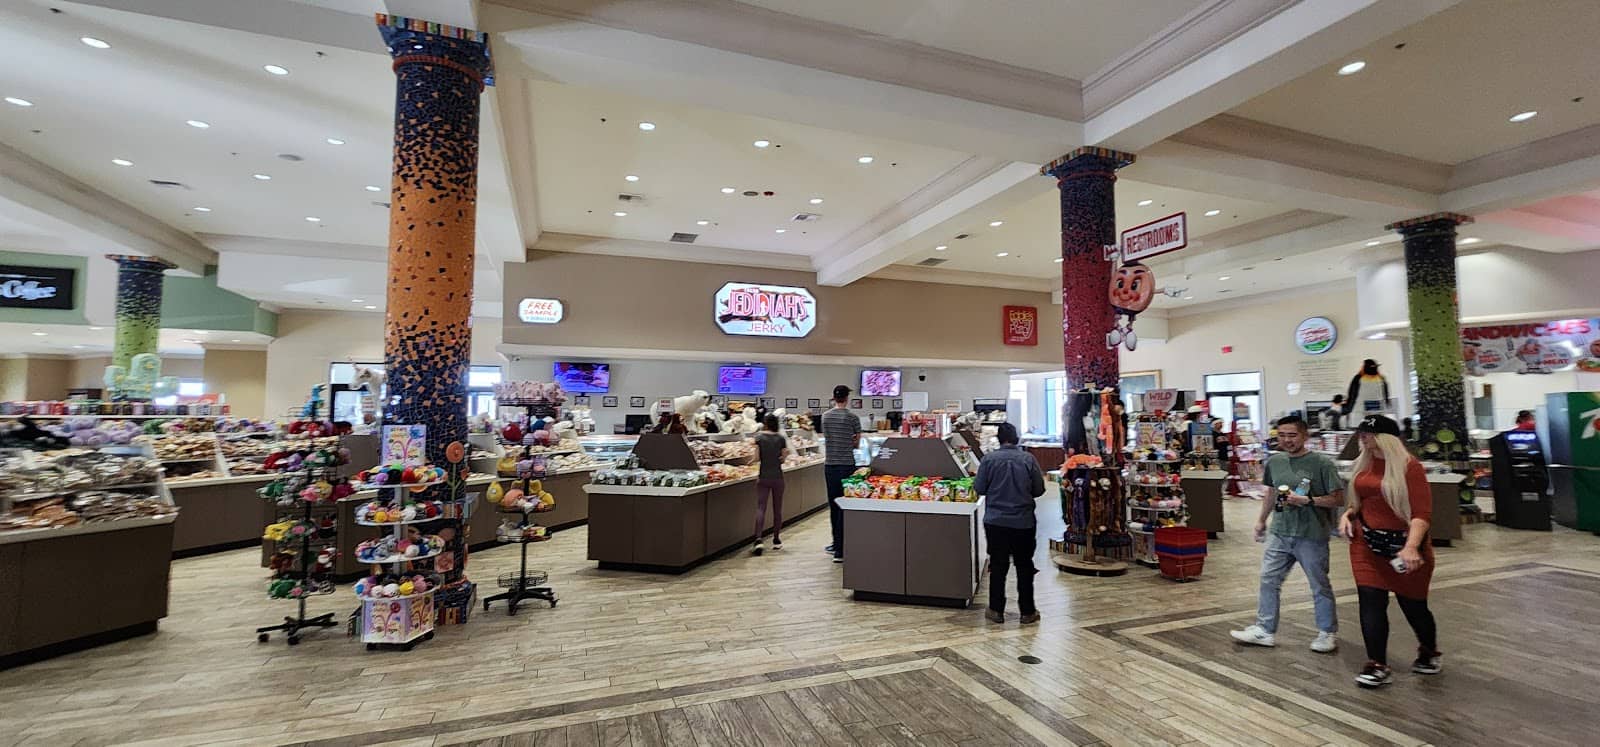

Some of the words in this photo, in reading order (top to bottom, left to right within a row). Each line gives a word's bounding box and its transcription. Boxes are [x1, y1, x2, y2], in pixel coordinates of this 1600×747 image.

[1126, 222, 1180, 255] RESTROOMS
[527, 302, 554, 310] FREE
[747, 322, 787, 333] JERKY
[1149, 391, 1172, 401] WILD
